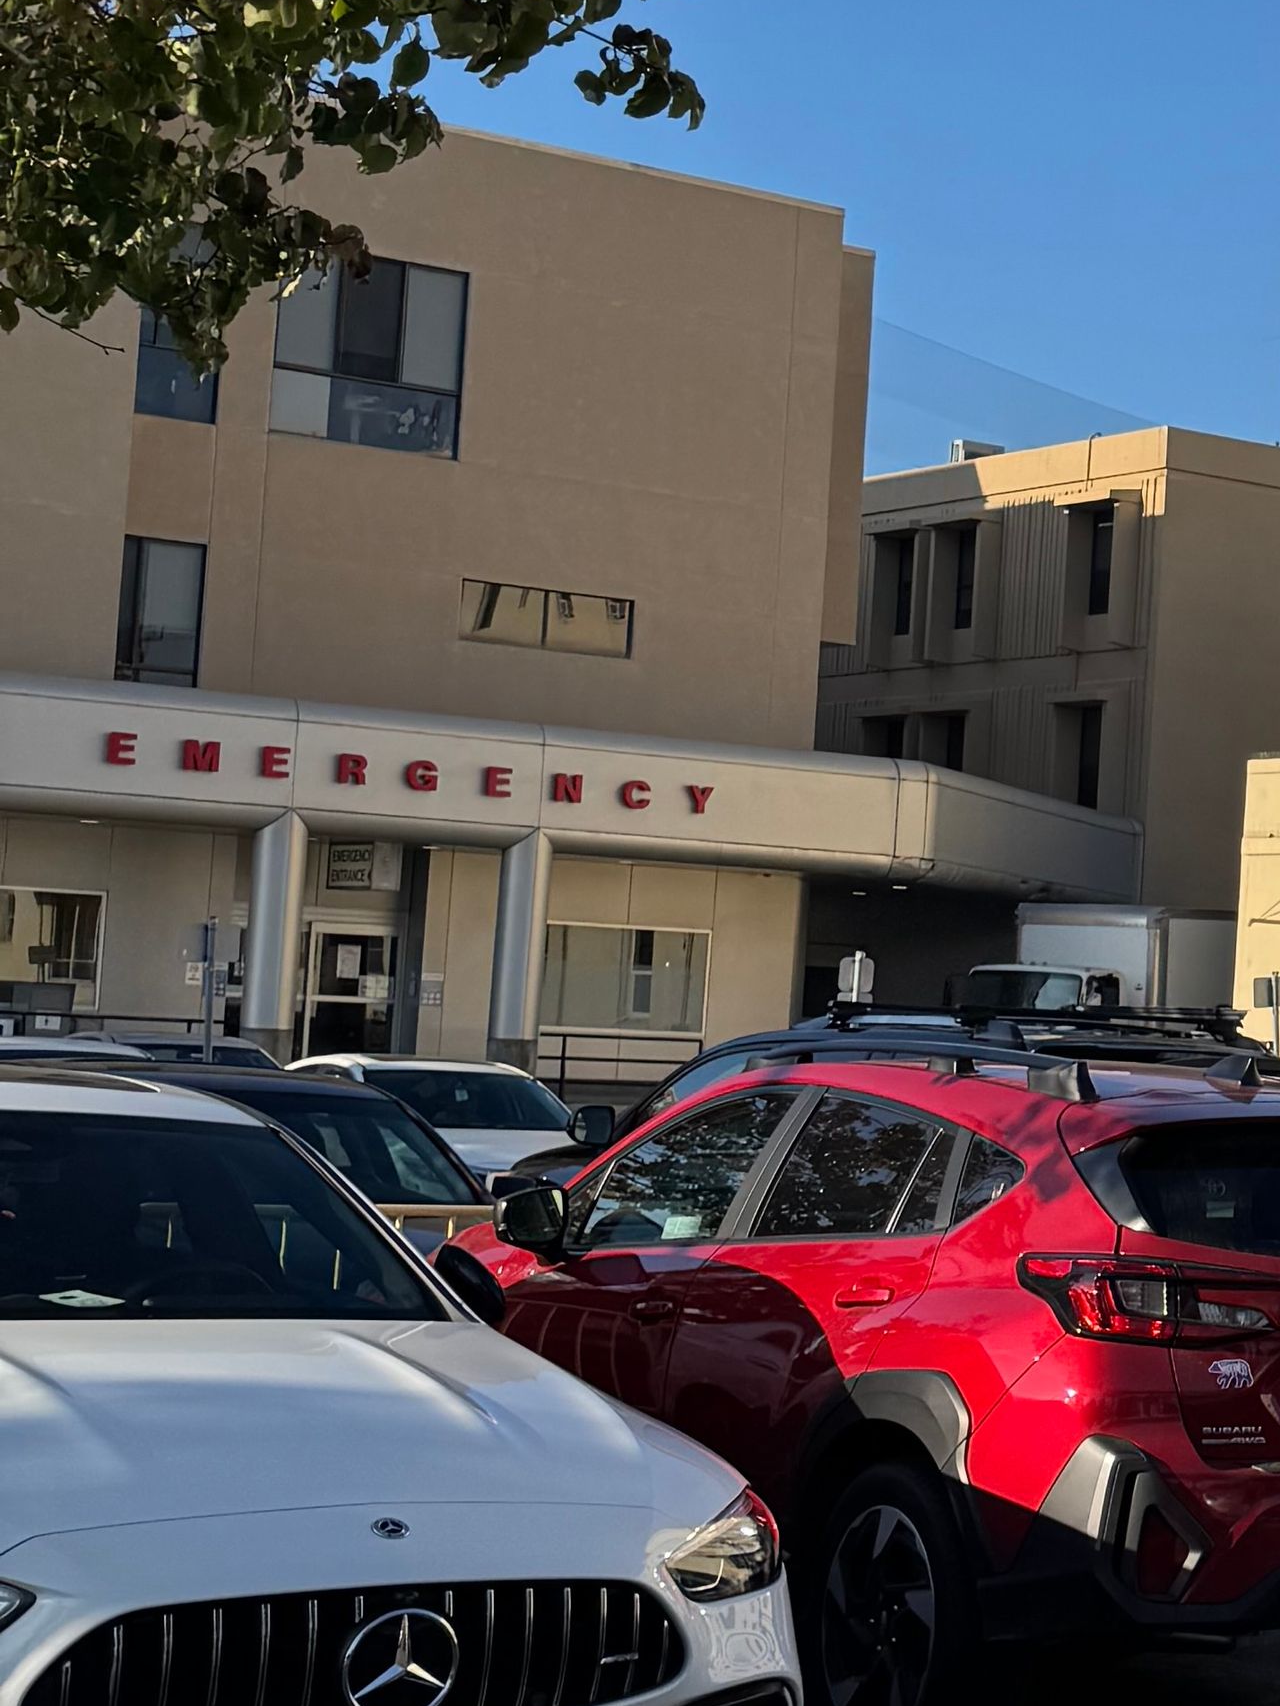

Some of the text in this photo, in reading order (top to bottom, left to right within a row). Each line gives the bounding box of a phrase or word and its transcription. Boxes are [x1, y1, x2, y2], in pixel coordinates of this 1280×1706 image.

[105, 731, 714, 814] EMERGENCY
[332, 849, 370, 863] EMERGENC
[1202, 1425, 1262, 1434] SUBARU
